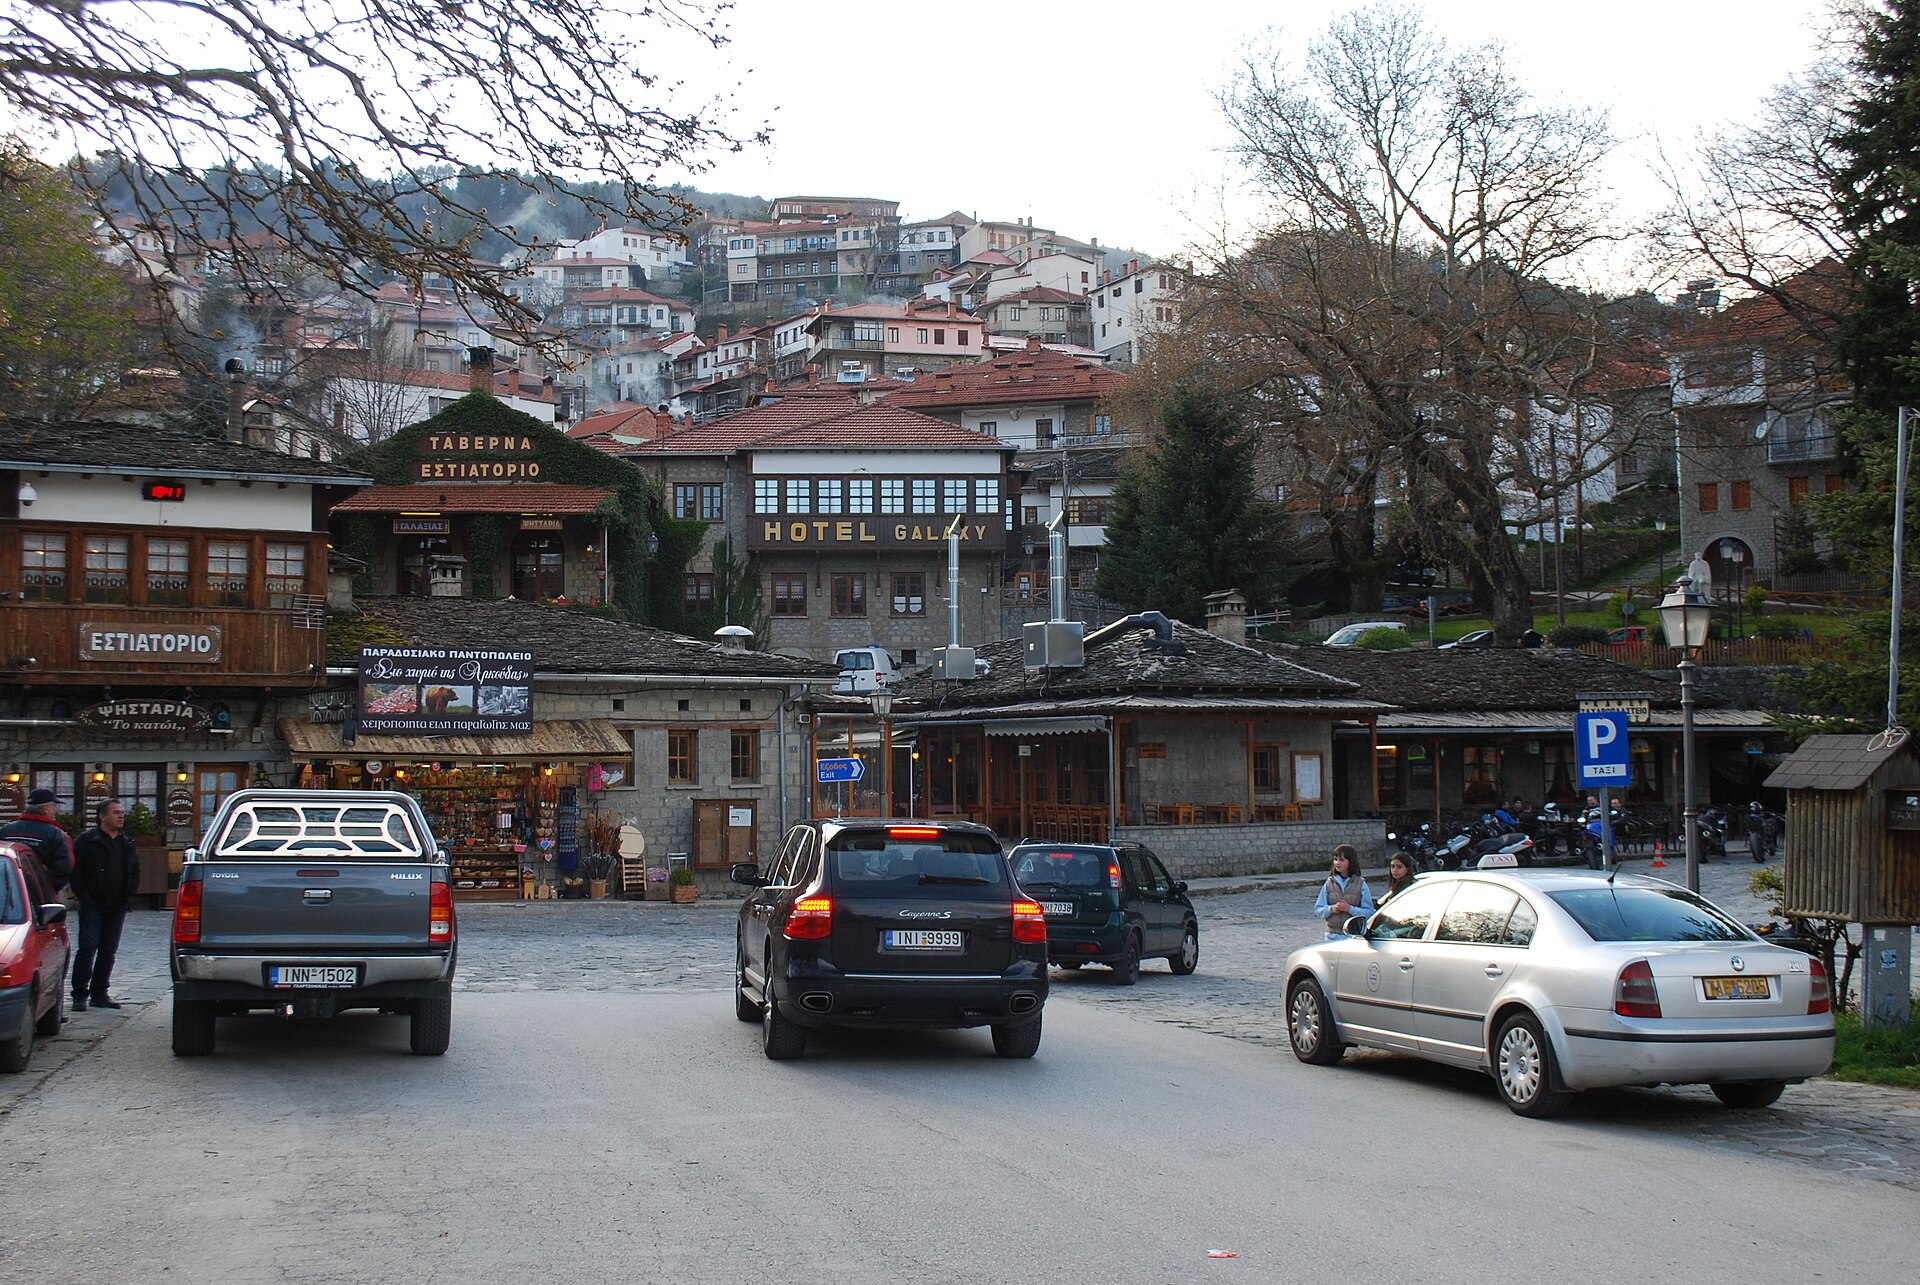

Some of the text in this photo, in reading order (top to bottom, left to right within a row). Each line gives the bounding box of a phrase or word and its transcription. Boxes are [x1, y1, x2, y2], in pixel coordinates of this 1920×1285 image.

[430, 436, 531, 450] ΤΑΒΕΡΝΑ
[421, 463, 540, 478] ΕΣΤΙΑΤΟΡΙΟ
[764, 521, 986, 542] HOTEL GALAXY
[91, 632, 211, 653] ΕΣΤΙΑΤΟΡΙΟ
[363, 648, 532, 660] ΠΑΡΑΔΟΣΙΑΚΟ ΠΑΝΤΟΠΩΛΕΙΟ
[99, 703, 193, 718] ΨΗΣΤΑΡΙΑ
[1588, 718, 1617, 759] P
[820, 771, 835, 779] Exit
[1592, 766, 1615, 774] ΤΑΞΙ
[899, 909, 941, 920] Cayenne
